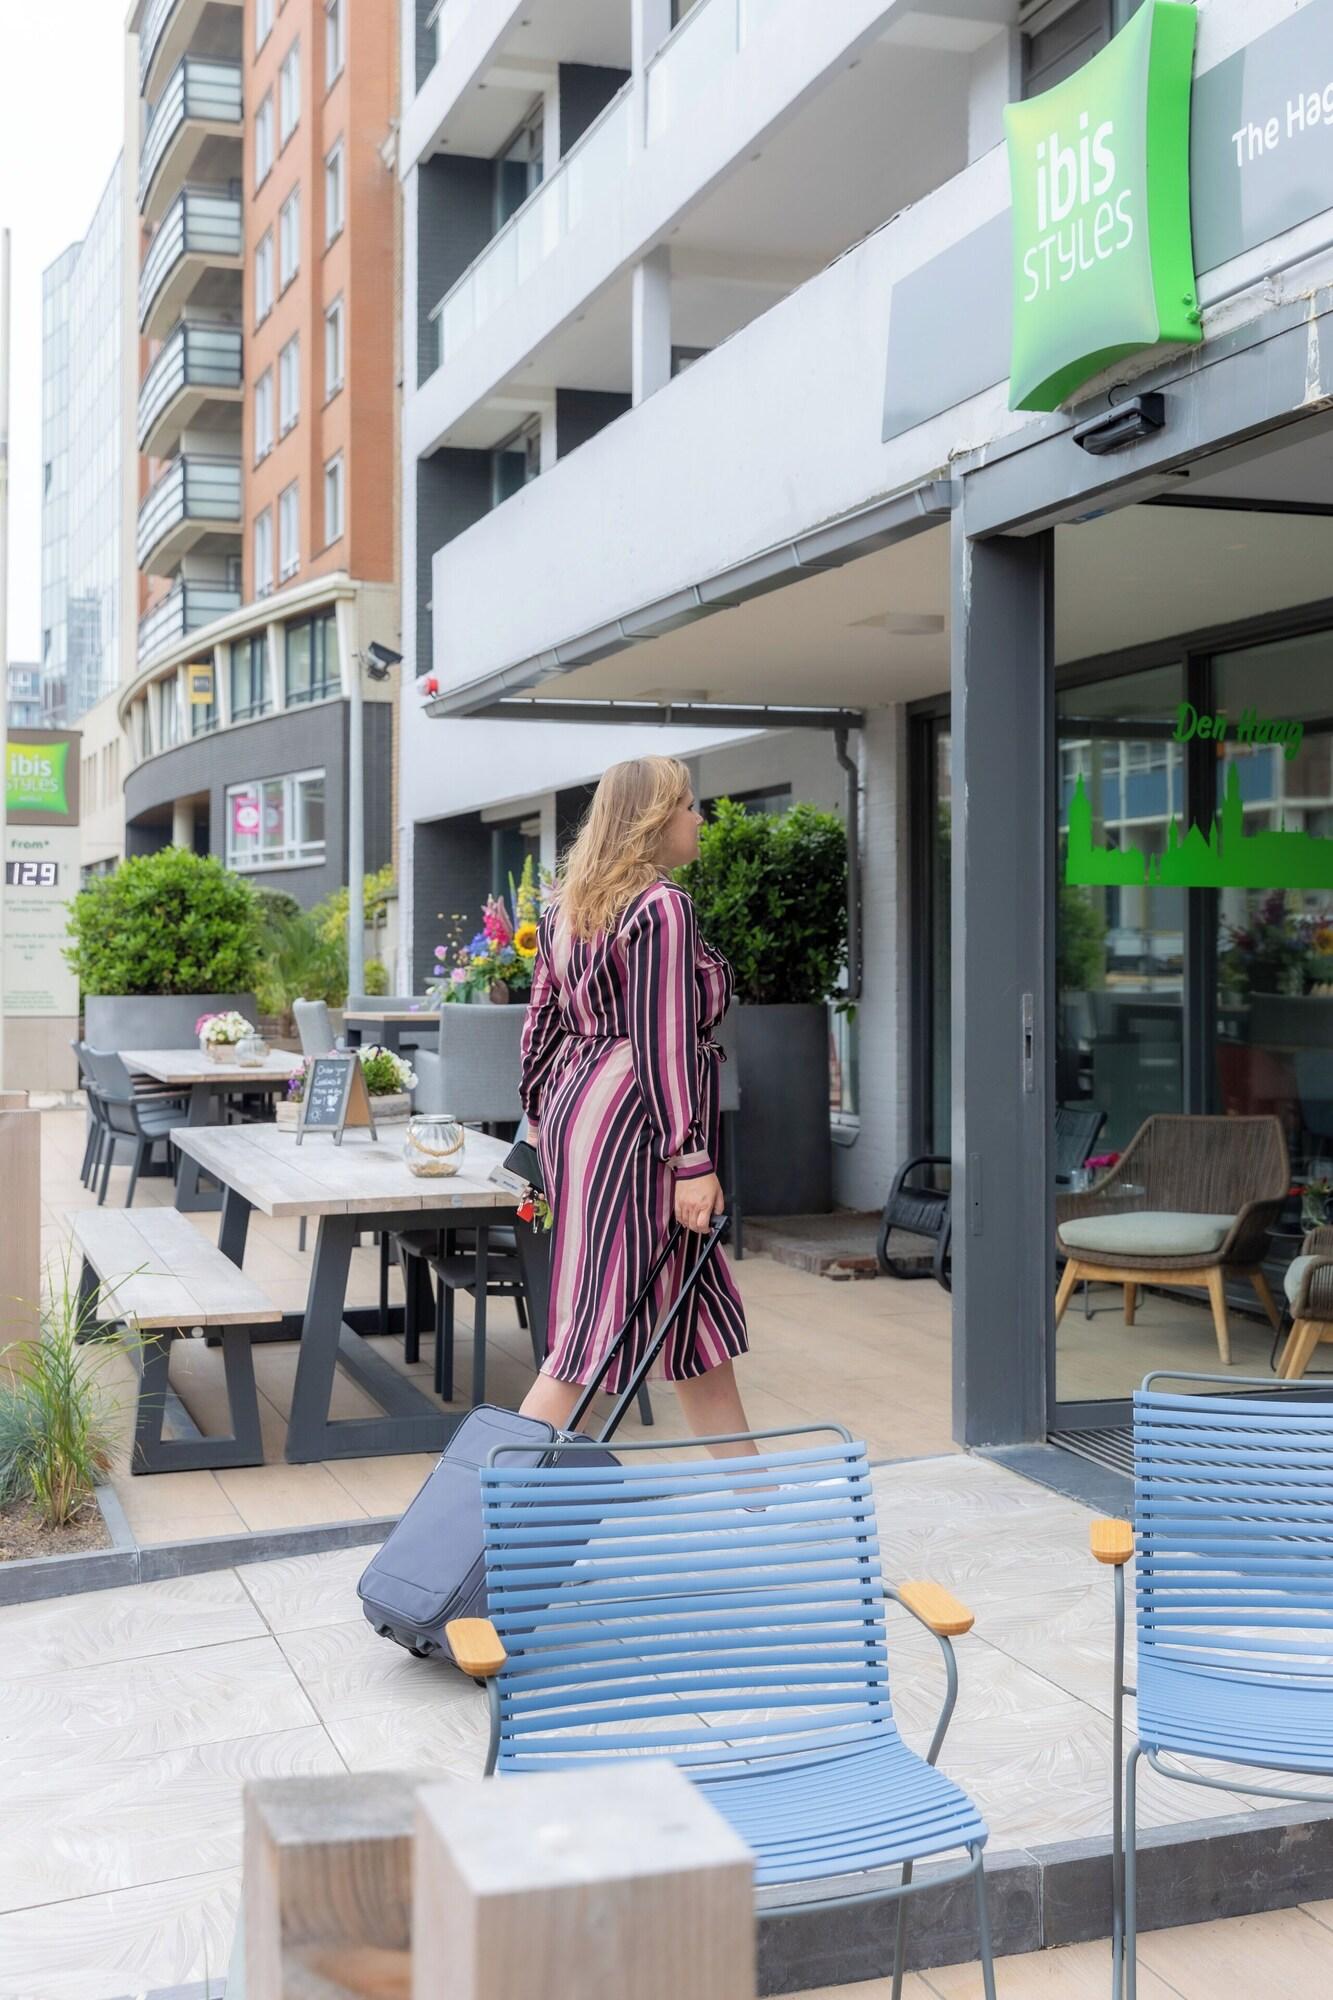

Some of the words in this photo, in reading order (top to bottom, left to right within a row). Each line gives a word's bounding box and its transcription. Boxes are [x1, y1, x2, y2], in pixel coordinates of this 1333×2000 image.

[1231, 117, 1279, 167] The
[1036, 111, 1115, 232] ibis
[1172, 702, 1227, 743] Den
[1236, 704, 1304, 761] Haag
[10, 751, 52, 777] ibis
[13, 862, 55, 886] 129
